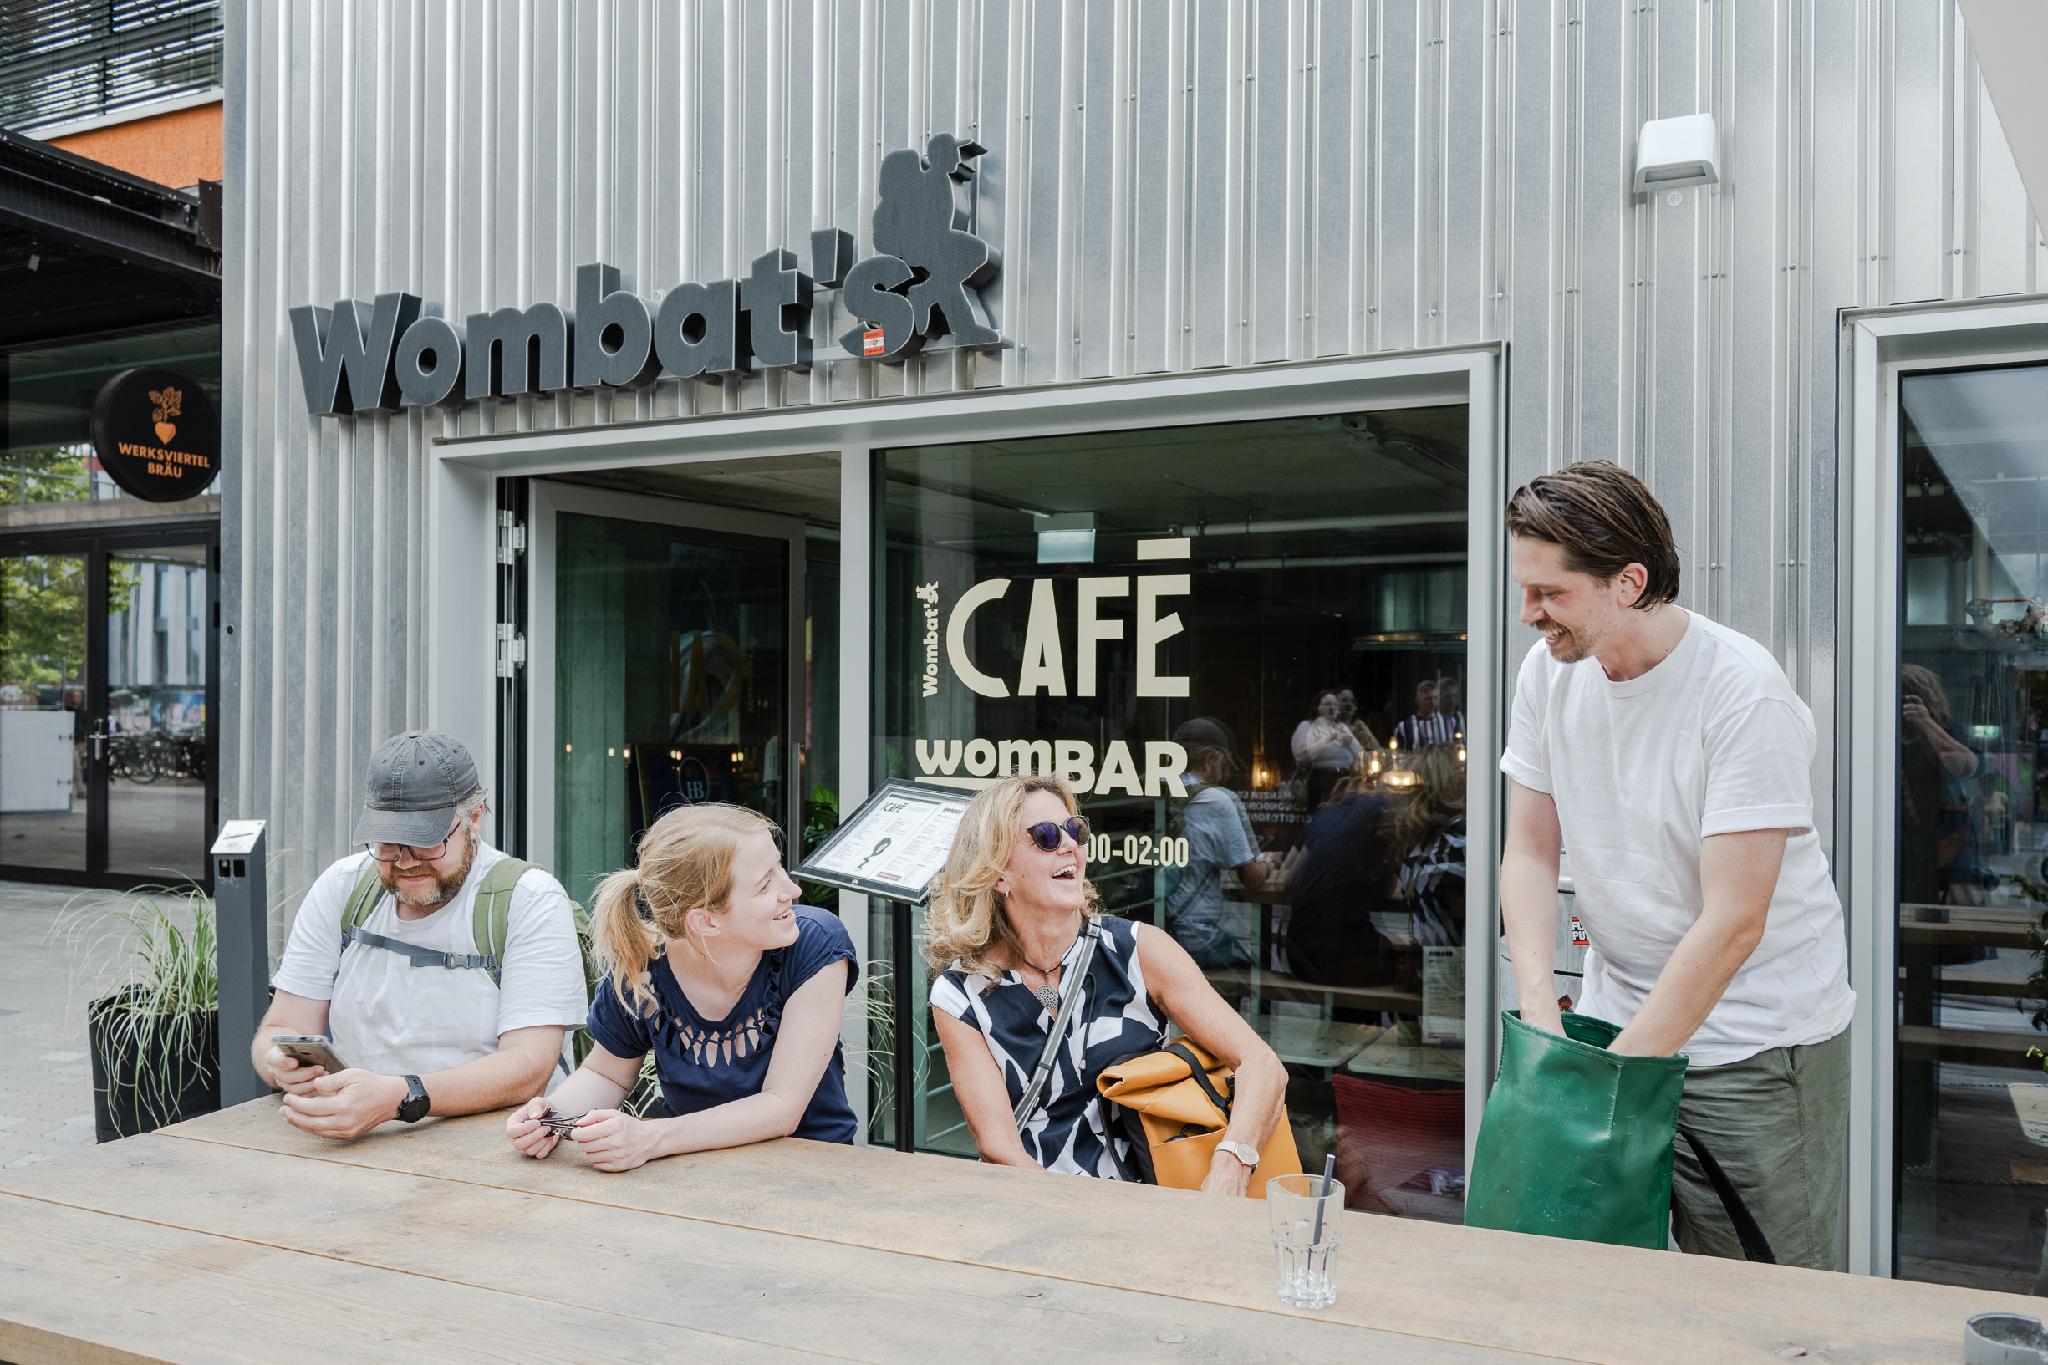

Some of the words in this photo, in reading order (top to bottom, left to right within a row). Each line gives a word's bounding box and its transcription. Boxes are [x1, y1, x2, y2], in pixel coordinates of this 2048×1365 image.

[289, 228, 915, 415] Wombat's
[118, 442, 211, 468] WERKSVIERTEL
[147, 461, 182, 478] BRÄU
[922, 582, 939, 698] Wombat's
[946, 537, 1191, 698] CAFÉ
[1087, 833, 1189, 868] 00-02:00
